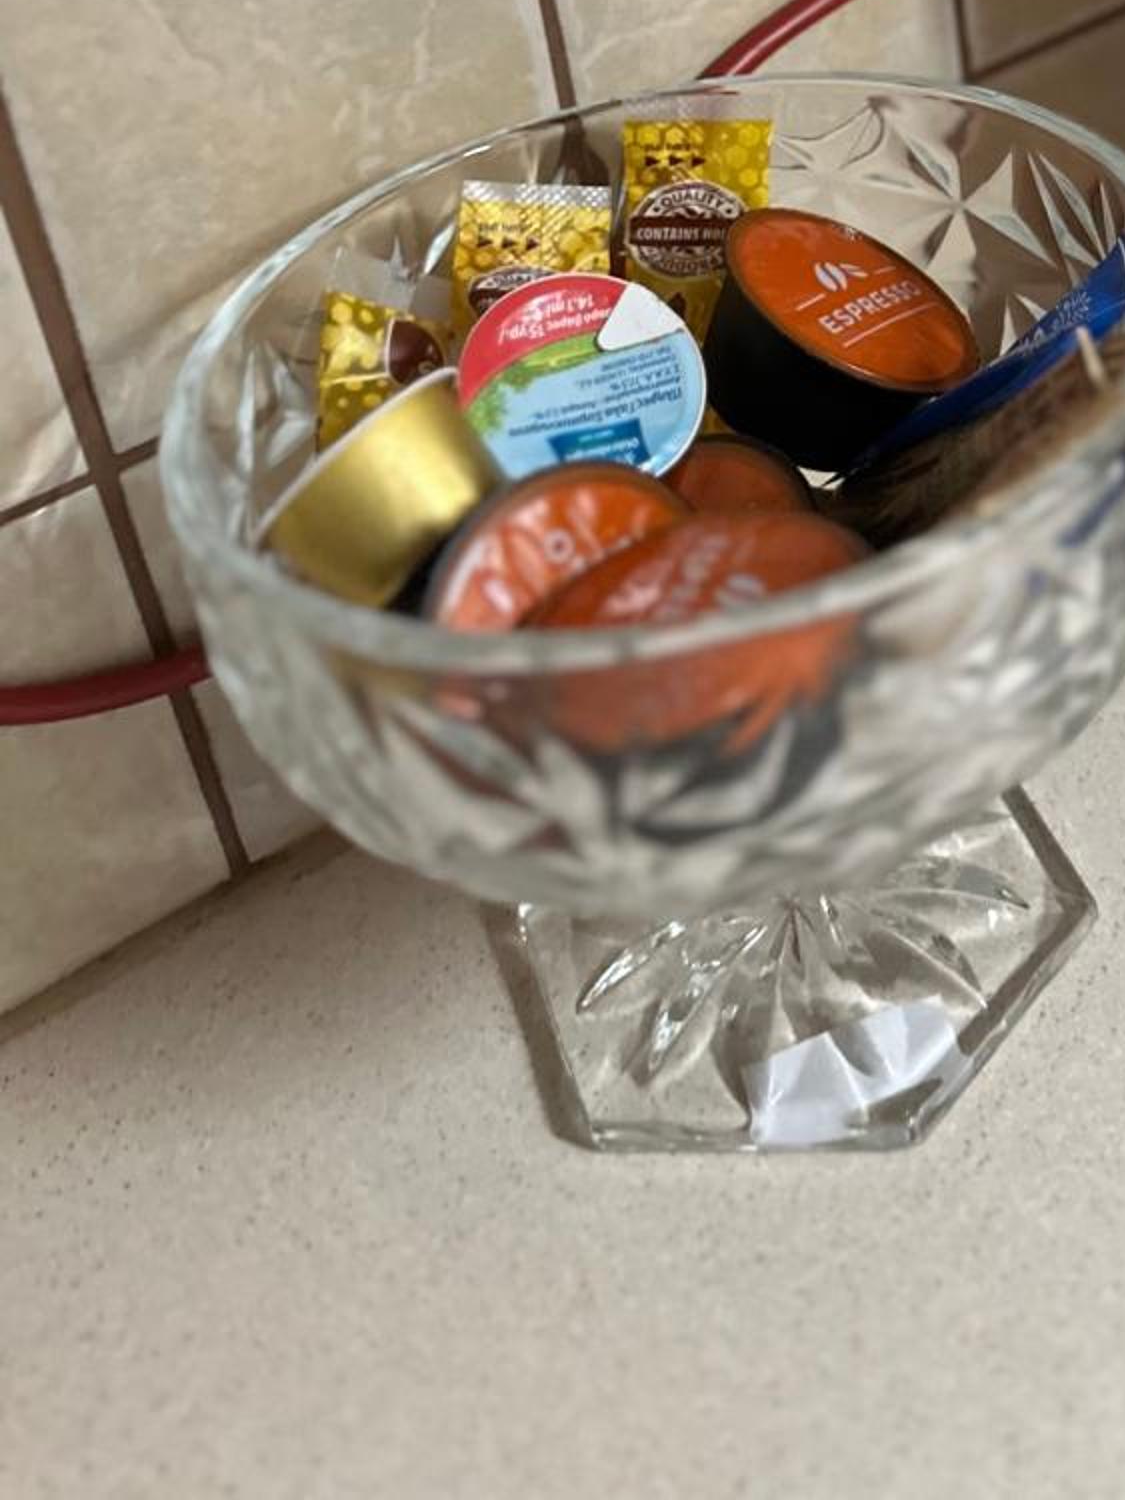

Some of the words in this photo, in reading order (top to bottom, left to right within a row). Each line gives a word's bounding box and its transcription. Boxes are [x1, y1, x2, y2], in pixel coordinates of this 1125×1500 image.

[660, 189, 728, 211] QUALITY
[636, 226, 700, 242] CONTAINS
[818, 280, 921, 334] ESPRESSO
